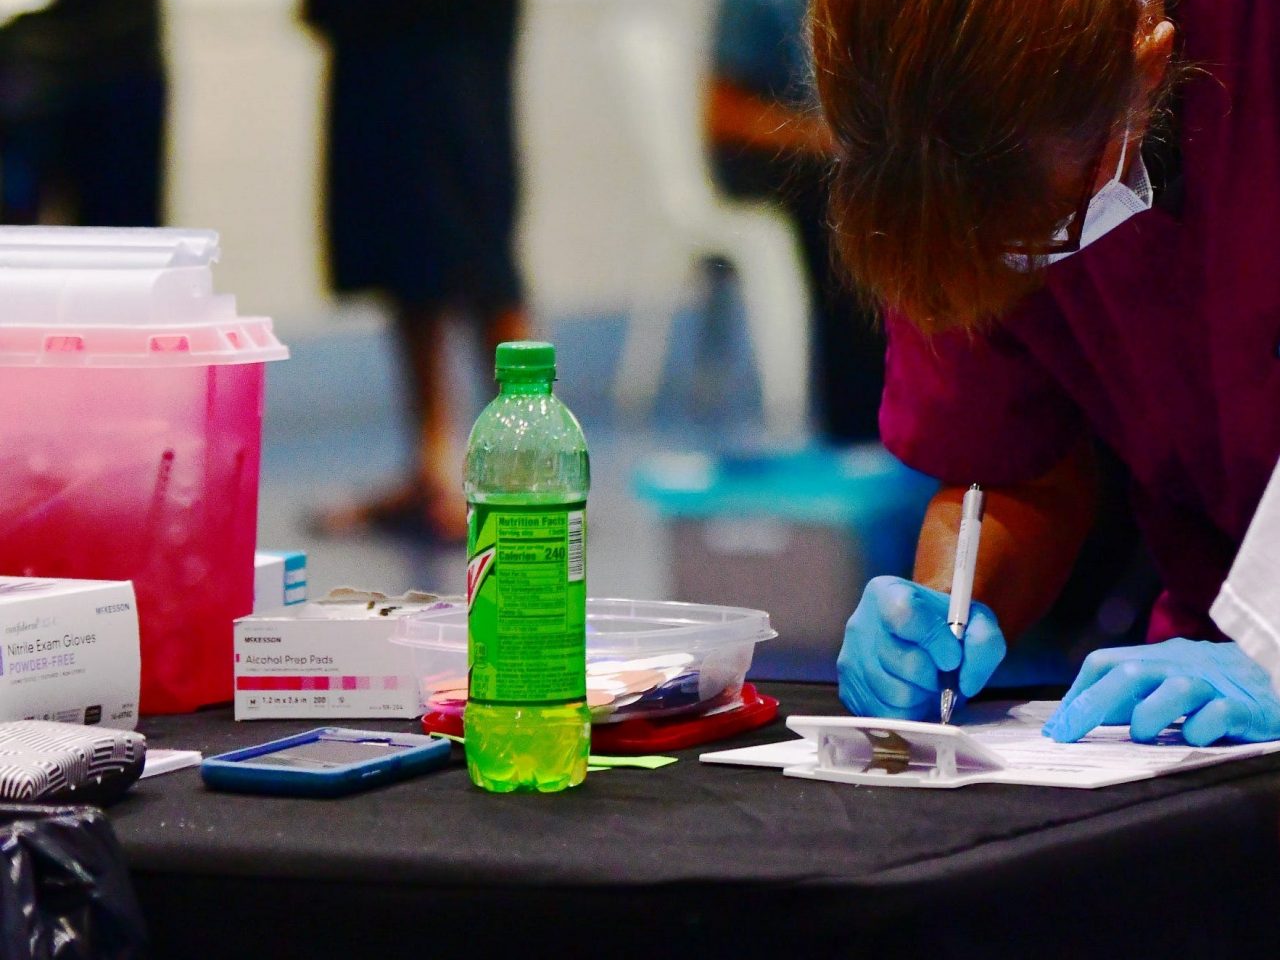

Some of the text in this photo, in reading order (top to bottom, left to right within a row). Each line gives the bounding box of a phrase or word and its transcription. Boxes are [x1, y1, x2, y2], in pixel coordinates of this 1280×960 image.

[498, 516, 566, 527] Nutrition Facts
[498, 547, 566, 561] Calories 240
[7, 633, 97, 656] Nitrile Exam Gloves
[9, 653, 76, 674] POWDER-FREE
[246, 654, 334, 666] Alcohol Prep Pads
